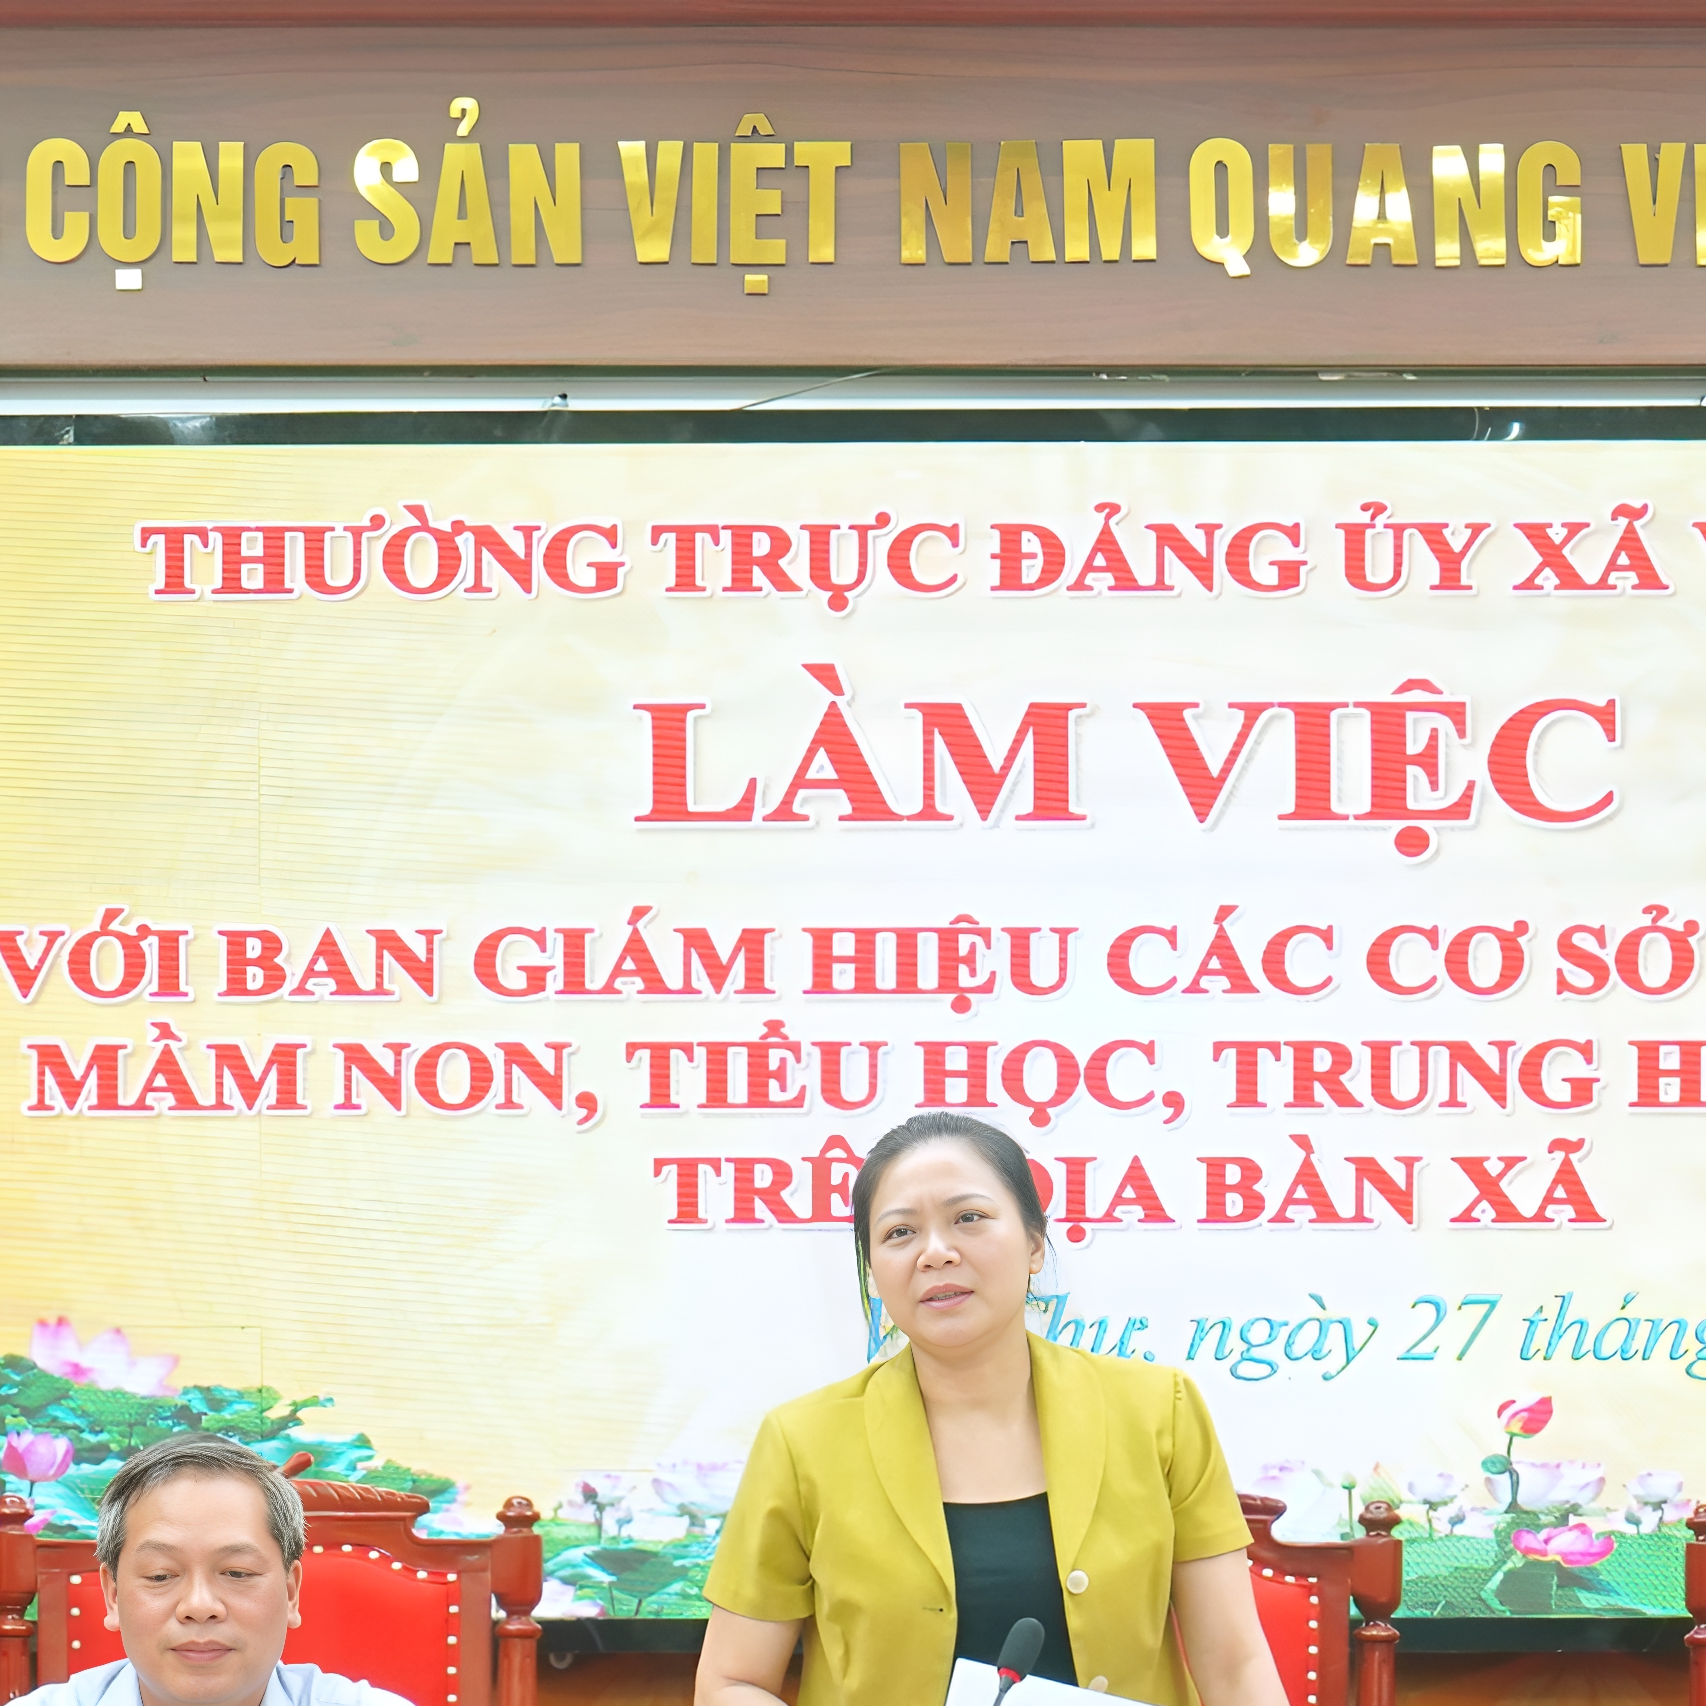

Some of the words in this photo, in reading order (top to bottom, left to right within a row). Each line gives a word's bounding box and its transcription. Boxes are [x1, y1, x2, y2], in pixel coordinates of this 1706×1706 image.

[25, 110, 320, 290] CỘNG
[353, 97, 583, 265] SẢN
[618, 113, 852, 294] VIỆT
[899, 138, 1158, 265] NAM
[1189, 137, 1583, 278] QUANG
[140, 504, 625, 595] THƯỜNG
[650, 511, 960, 612] TRỰC
[990, 502, 1308, 592] ĐẢNG
[1335, 501, 1490, 593] ỦY
[1513, 503, 1669, 592] XÃ
[633, 663, 1087, 823] LÀM
[1132, 677, 1619, 858] VIỆC
[218, 928, 443, 998] BAN
[473, 905, 775, 998] GIÁM
[802, 914, 1078, 1015] HIỆU
[1106, 905, 1335, 997] CÁC
[1366, 919, 1530, 997] CƠ
[1556, 904, 1700, 997] SỞ
[27, 1021, 307, 1112] MẦM
[333, 1041, 599, 1127] NON,
[626, 1019, 887, 1112] TIỂU
[914, 1039, 1185, 1128] HỌC,
[1212, 1039, 1600, 1112] TRUNG
[653, 1134, 859, 1225] TRÊ
[1198, 1134, 1422, 1226] BÀN
[1450, 1137, 1608, 1225] XÃ
[1186, 1292, 1379, 1382] ngày
[1397, 1294, 1502, 1362] 27
